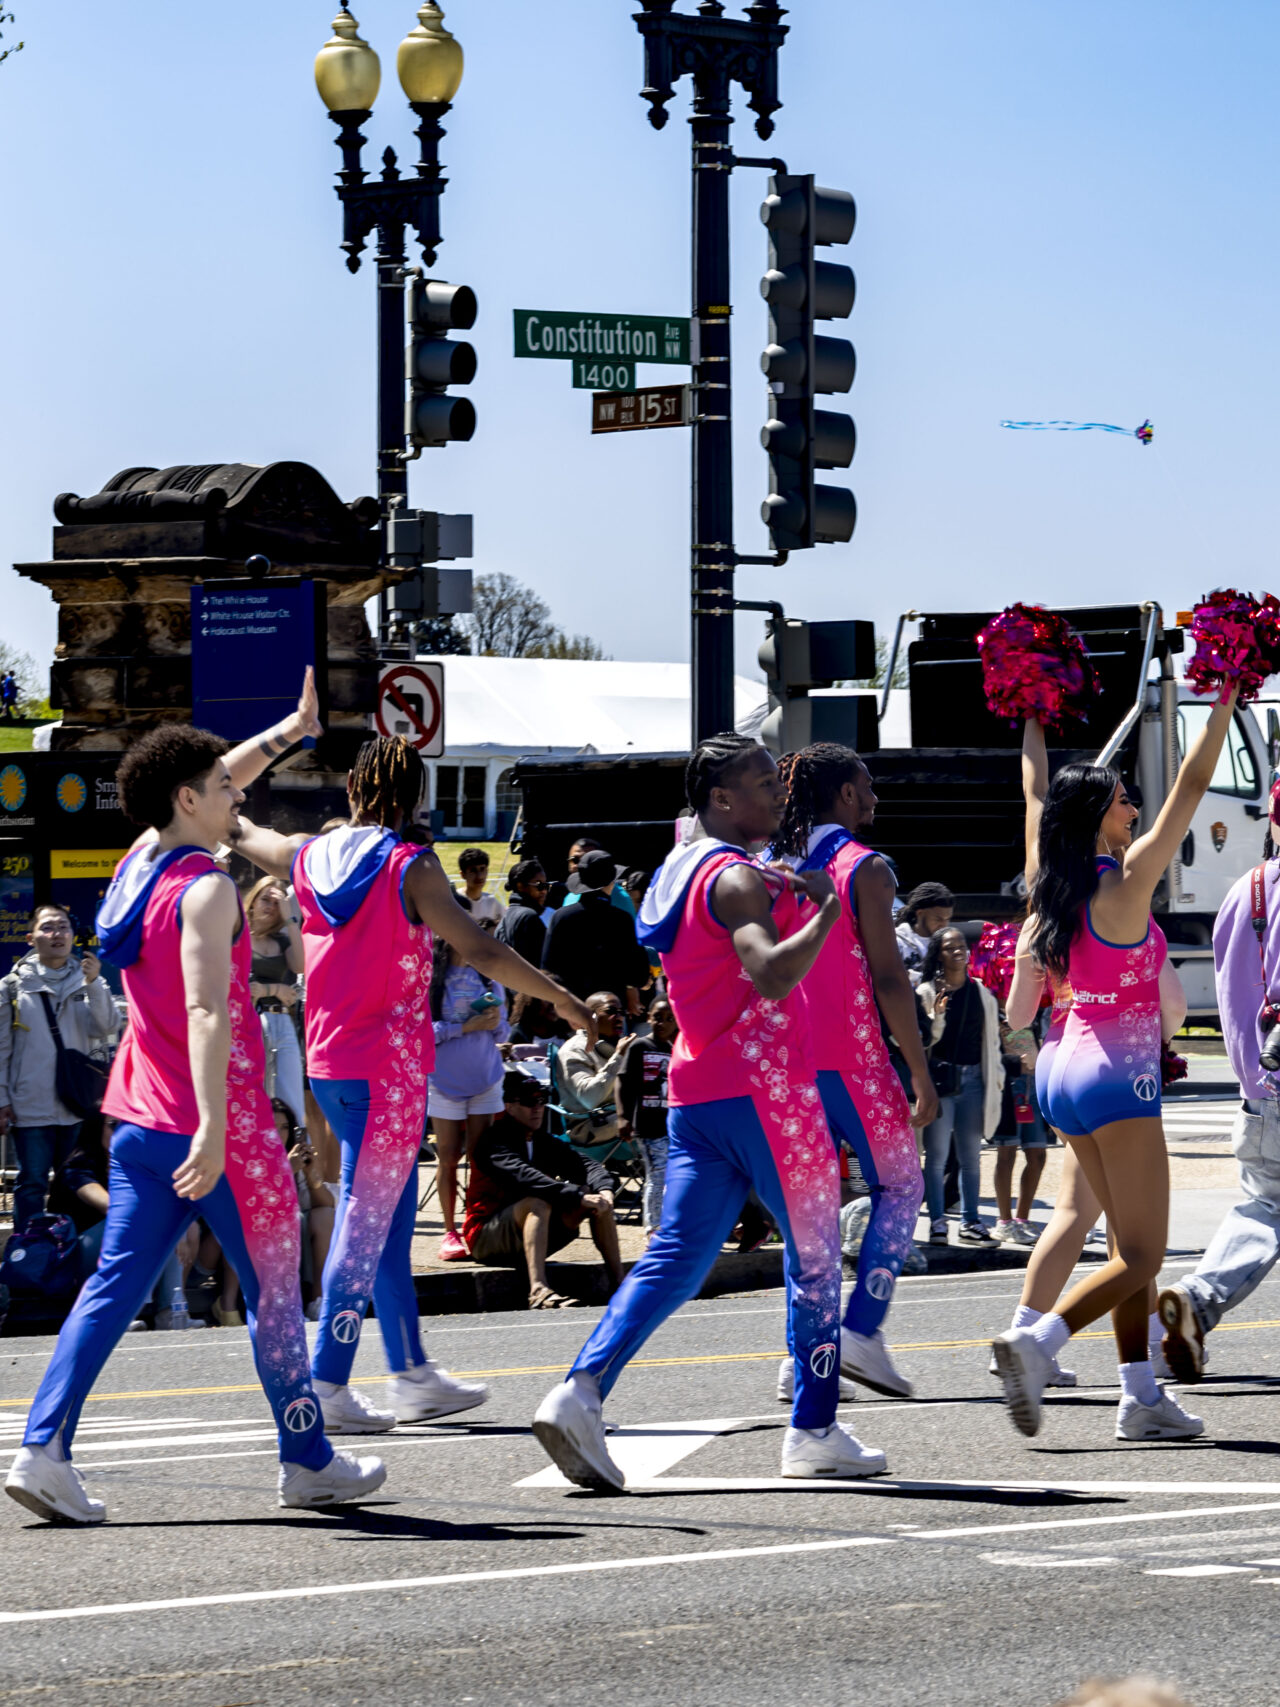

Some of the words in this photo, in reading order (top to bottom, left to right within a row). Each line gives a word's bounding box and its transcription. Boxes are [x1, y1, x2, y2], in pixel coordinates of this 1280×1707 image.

[526, 316, 657, 356] Constitution
[664, 322, 680, 340] Ave
[664, 341, 681, 358] NW
[579, 364, 629, 389] 1400
[599, 403, 616, 421] NW
[638, 394, 662, 422] 15
[663, 397, 676, 416] ST
[246, 595, 268, 603] House
[232, 611, 254, 619] House
[210, 627, 245, 635] Holocaust
[2, 856, 29, 876] 250
[62, 860, 98, 868] Welcome
